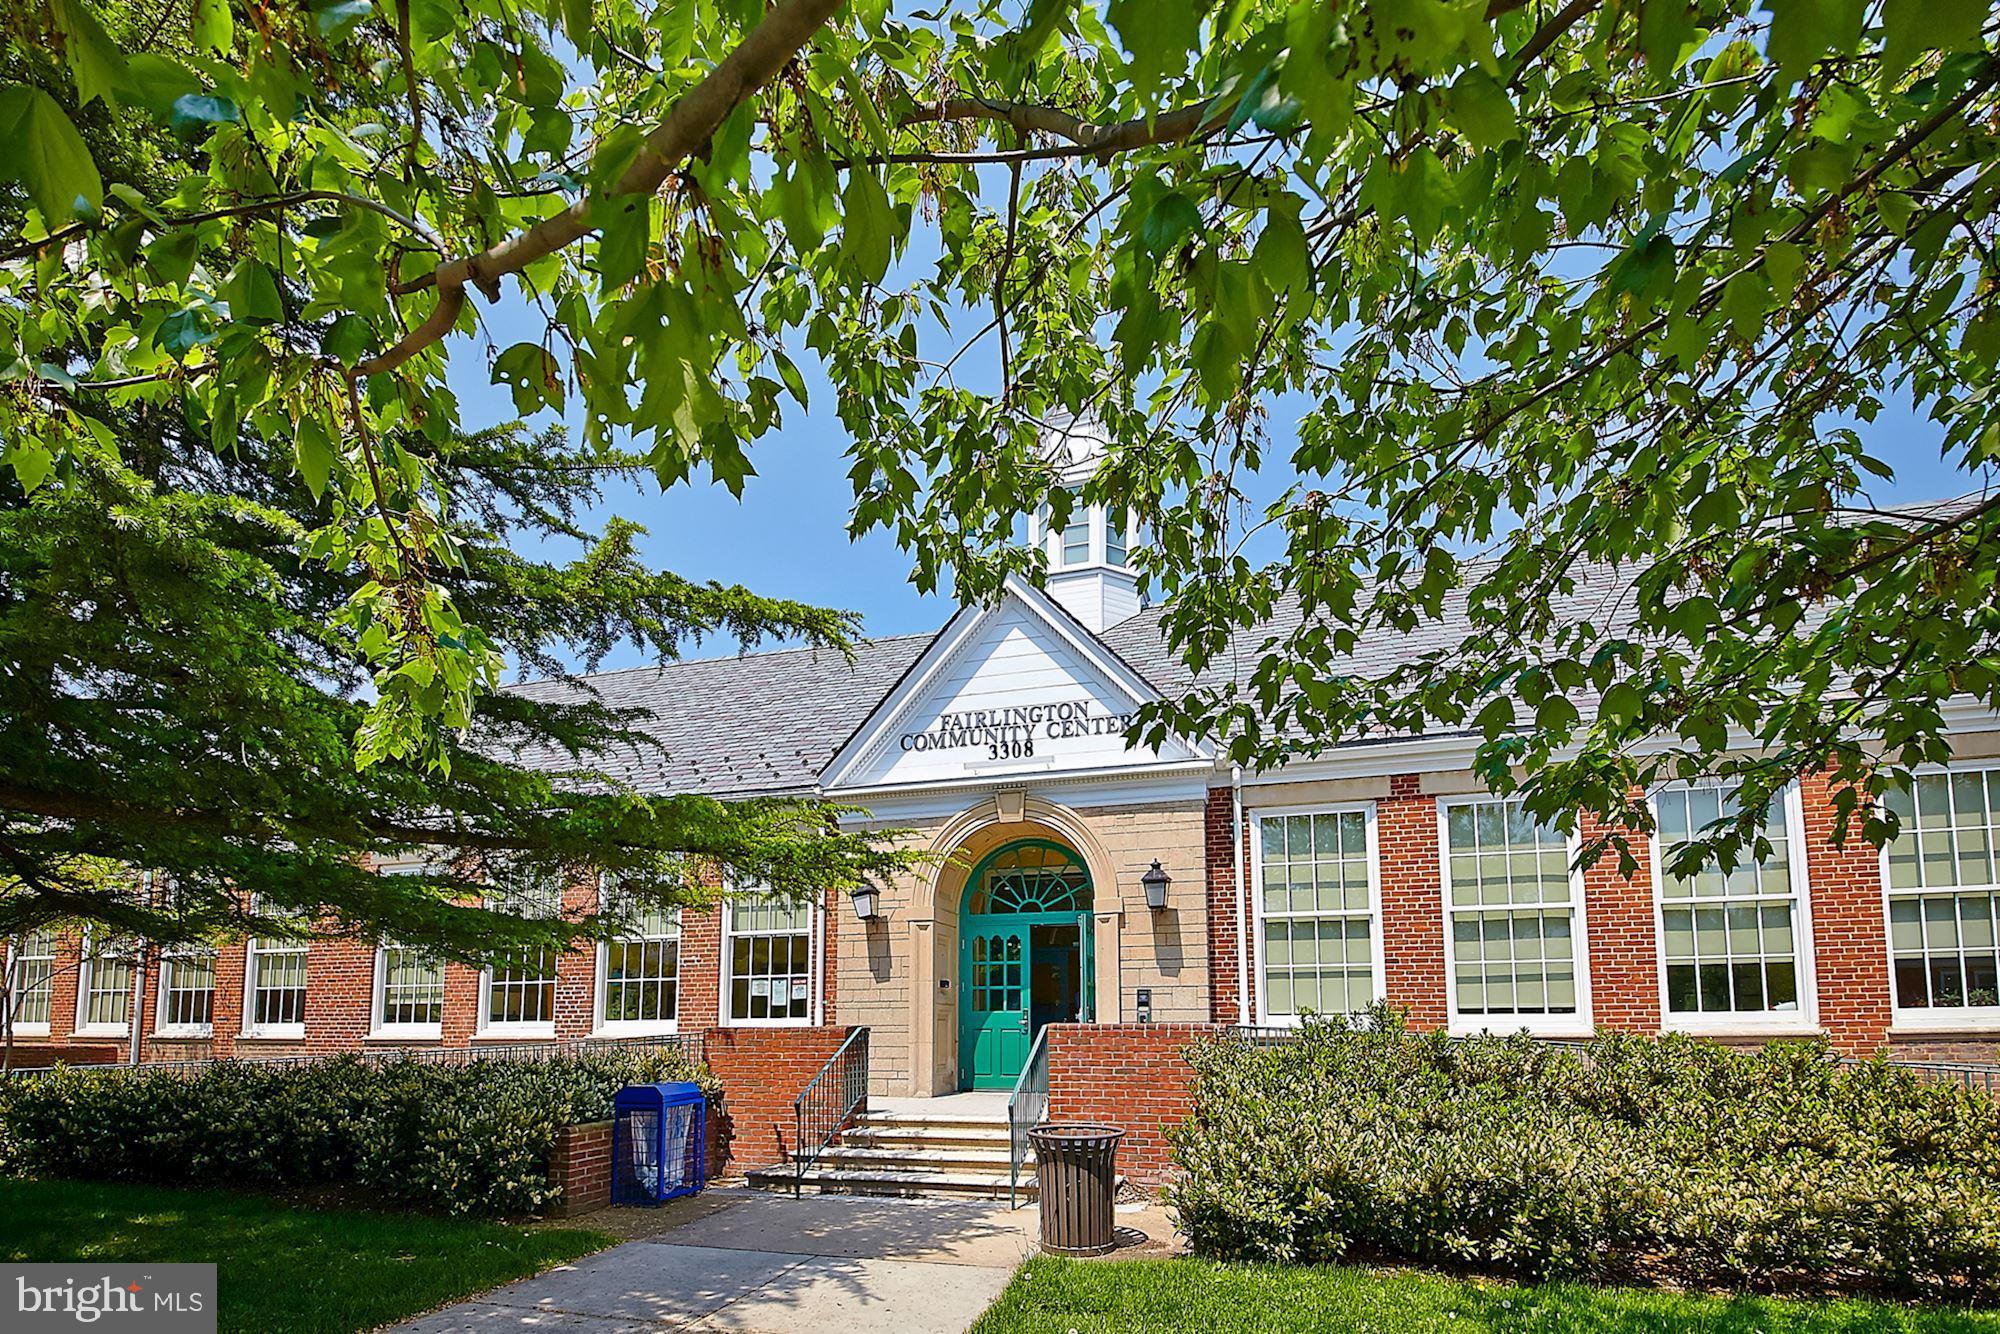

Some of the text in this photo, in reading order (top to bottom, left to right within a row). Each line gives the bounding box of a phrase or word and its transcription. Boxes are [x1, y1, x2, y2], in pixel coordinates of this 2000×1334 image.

[940, 701, 1089, 731] FAIRLINGTON
[900, 714, 1133, 751] COMMUNITY CENTER
[988, 740, 1034, 760] 3308
